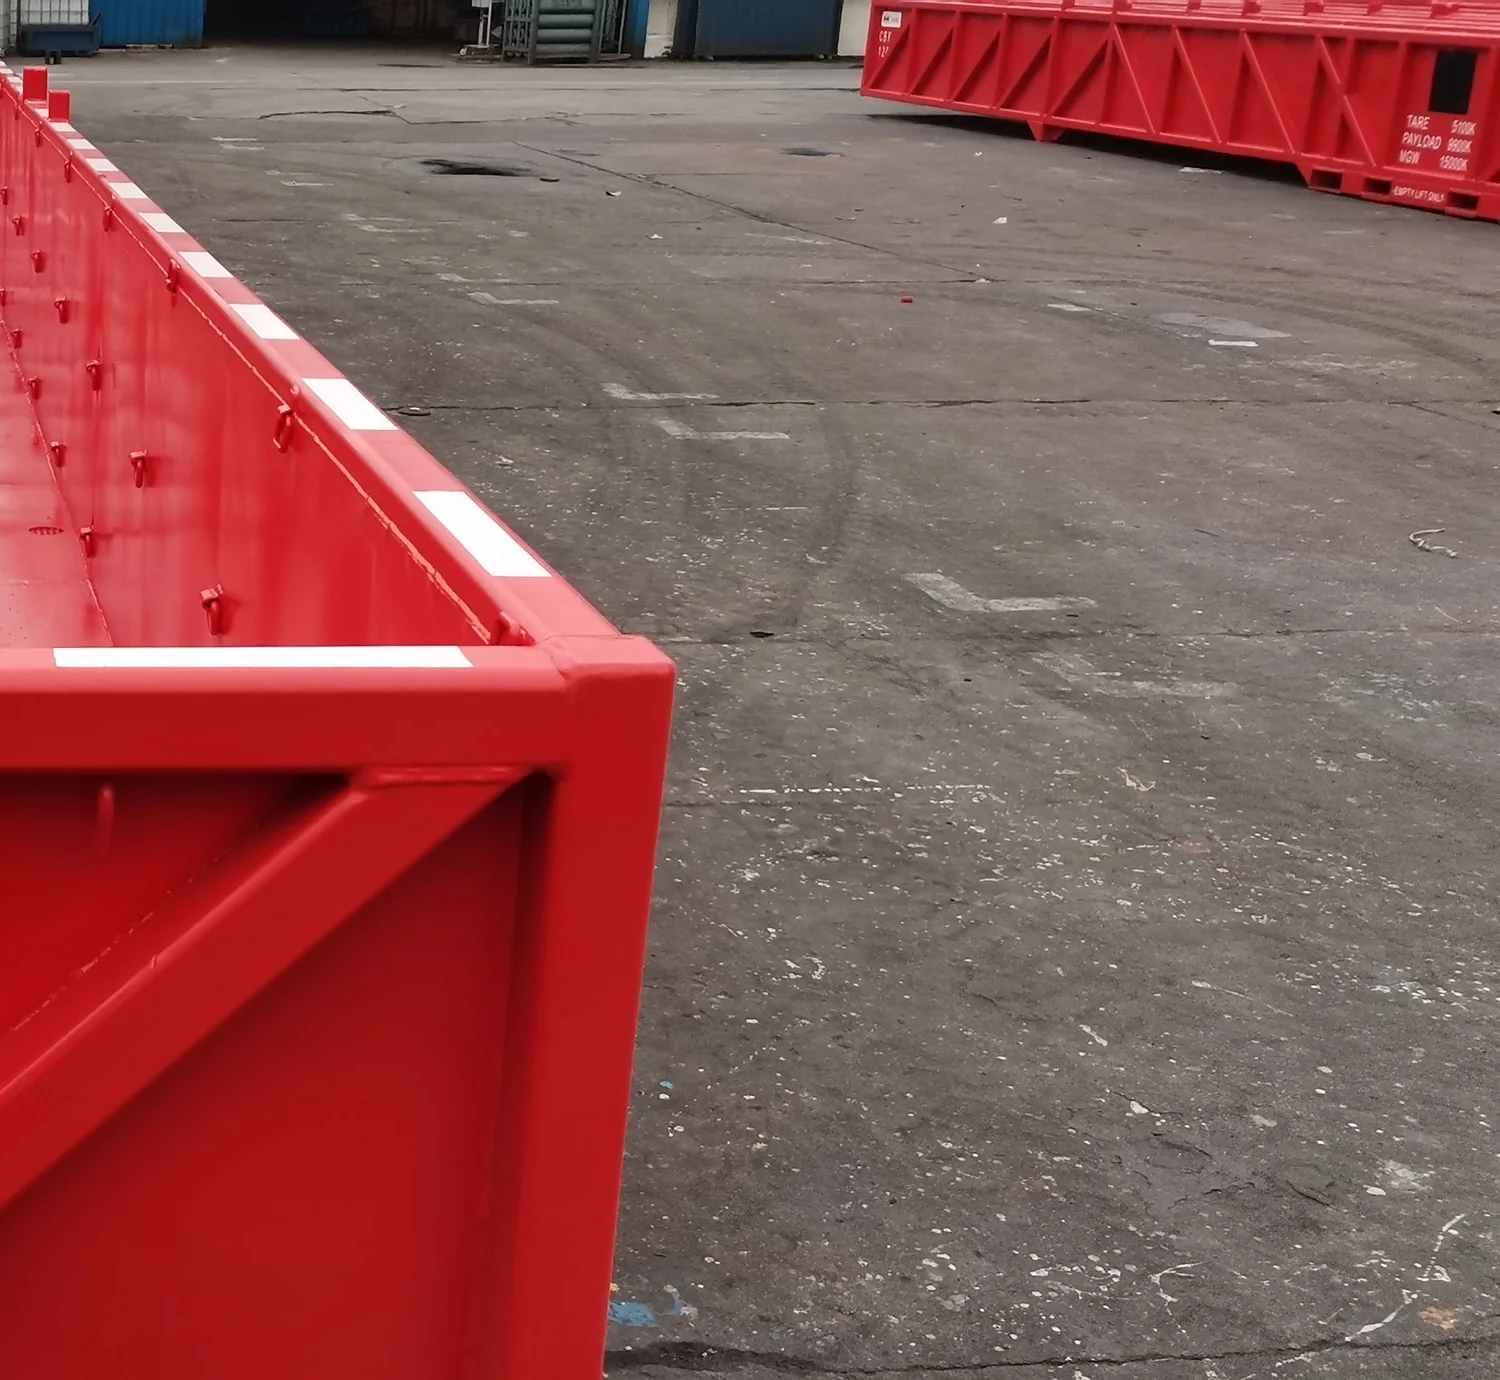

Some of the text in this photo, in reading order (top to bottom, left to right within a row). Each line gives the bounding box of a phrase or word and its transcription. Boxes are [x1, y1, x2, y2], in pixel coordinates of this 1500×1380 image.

[1407, 114, 1476, 135] TARE 5100K
[1402, 132, 1442, 150] PAYLOAD
[1399, 149, 1468, 171] MGW 15000K
